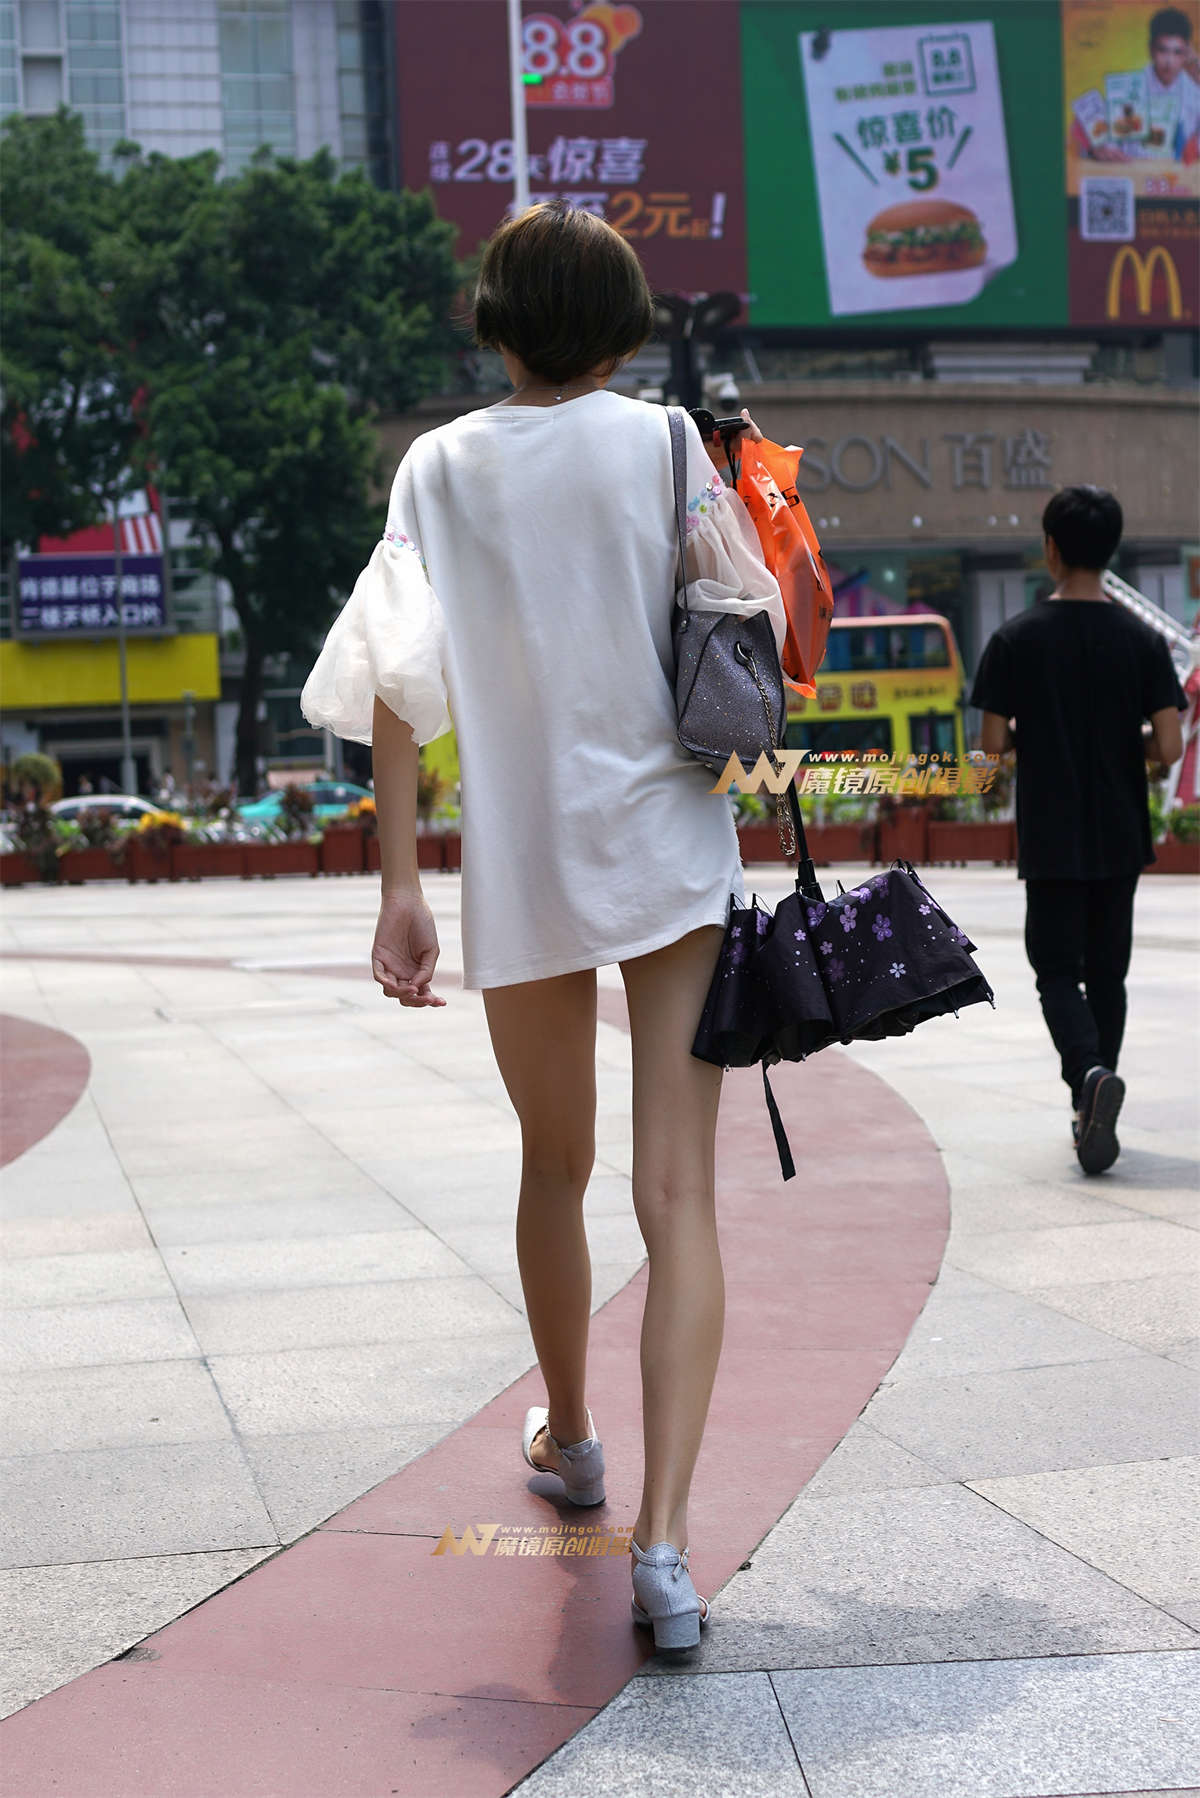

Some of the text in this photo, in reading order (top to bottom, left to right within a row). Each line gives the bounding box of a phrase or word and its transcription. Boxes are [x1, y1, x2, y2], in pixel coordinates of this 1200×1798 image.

[857, 106, 957, 149] 惊喜价
[944, 428, 1053, 490] 百盛
[20, 575, 161, 599] 肯德基位于商场
